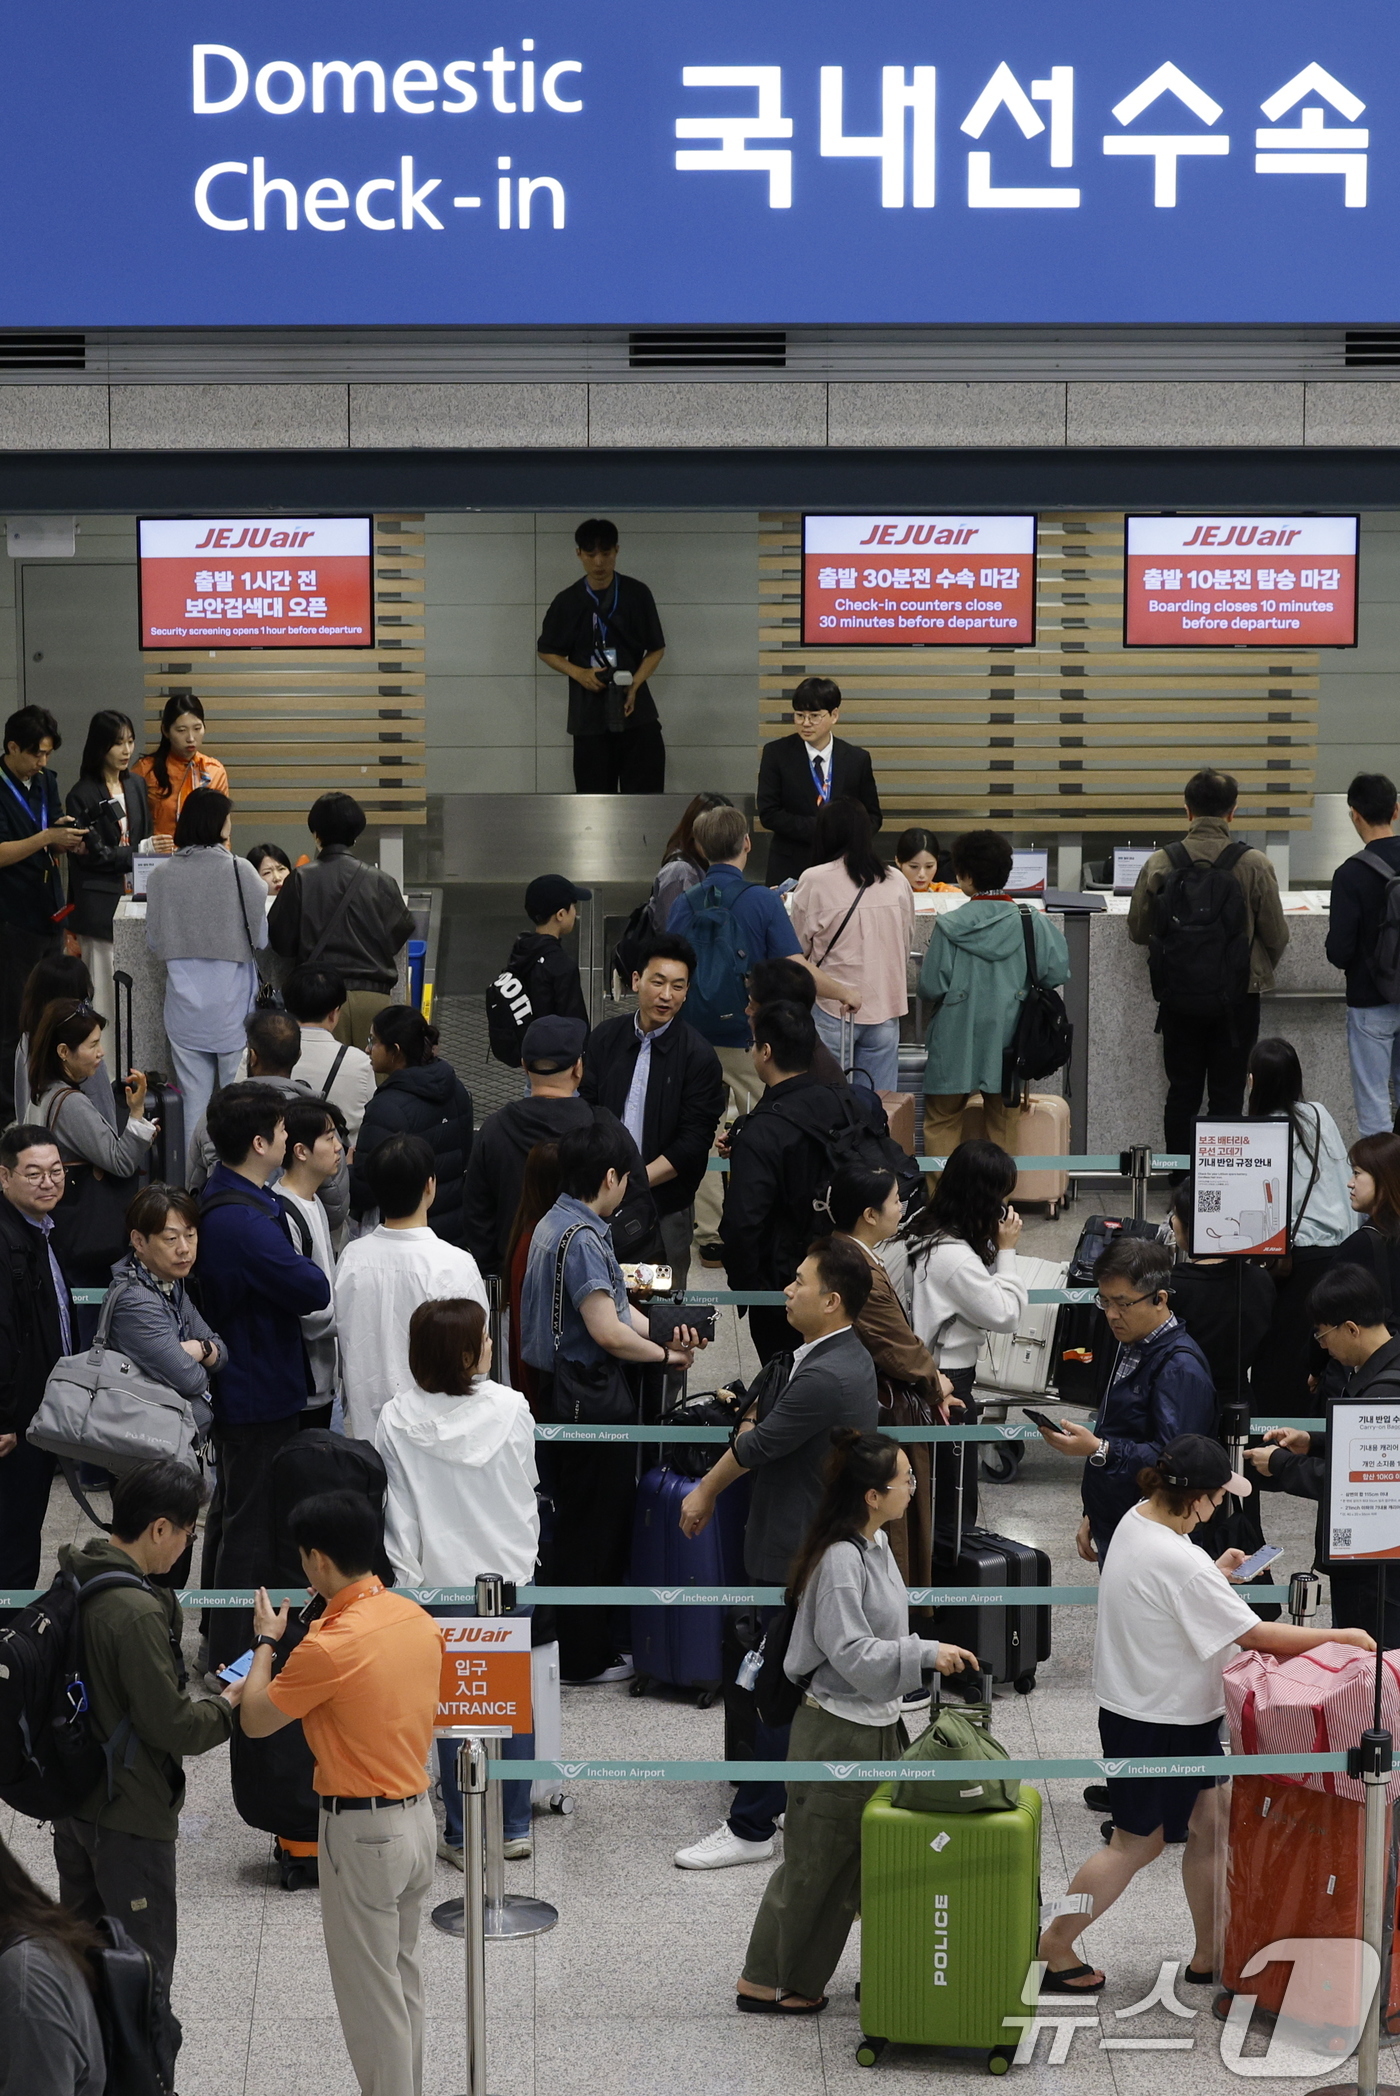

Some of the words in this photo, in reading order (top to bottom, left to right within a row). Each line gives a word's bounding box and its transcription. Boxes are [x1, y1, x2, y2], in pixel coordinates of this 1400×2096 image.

[192, 37, 583, 115] Domestic
[674, 60, 1370, 210] 국내선수속
[193, 154, 566, 233] Check-in
[195, 526, 315, 549] JEJUair
[859, 523, 980, 546] JEJUair
[1182, 524, 1303, 547] JEJUair
[194, 570, 234, 592] 출발
[241, 570, 292, 591] 1시간
[298, 570, 317, 591] 전
[818, 567, 858, 589] 출발
[862, 567, 931, 589] 30분전
[935, 567, 976, 589] 수속
[980, 567, 1020, 589] 마감
[1143, 568, 1183, 590] 출발
[1187, 568, 1252, 590] 10분전
[1256, 568, 1296, 590] 탑승
[1300, 568, 1341, 590] 마감
[184, 597, 283, 619] 보안검색대
[288, 597, 328, 618] 오픈
[835, 598, 897, 611] Check-in
[899, 599, 963, 611] counters
[965, 598, 1003, 611] close
[1149, 599, 1211, 615] Boarding
[1214, 600, 1257, 612] closes
[1260, 600, 1276, 612] 10
[1279, 600, 1334, 612] minutes
[818, 615, 837, 628] 30
[840, 615, 895, 628] minutes
[898, 615, 945, 628] before
[947, 615, 1018, 630] departure
[1182, 616, 1228, 629] before
[1231, 616, 1300, 631] departure
[150, 626, 187, 637] Security
[189, 626, 231, 637] screening
[233, 627, 259, 636] opens
[288, 625, 317, 635] before
[318, 625, 363, 636] departure
[1198, 1136, 1216, 1145] 보조
[1217, 1136, 1250, 1146] 배터리&
[1198, 1147, 1216, 1156] 무선
[1217, 1147, 1243, 1157] 고데기
[1198, 1158, 1216, 1168] 기내
[1217, 1158, 1234, 1168] 반입
[1235, 1158, 1253, 1168] 규정
[1254, 1158, 1272, 1168] 안내
[1358, 1415, 1374, 1424] 기내
[1375, 1415, 1391, 1423] 반입
[562, 1430, 596, 1439] Incheon
[598, 1431, 629, 1441] Airport
[1024, 1430, 1042, 1438] Inch
[189, 1596, 226, 1605] Incheon
[228, 1596, 255, 1606] Airpo
[682, 1594, 719, 1602] Incheon
[721, 1593, 755, 1603] Airport
[931, 1594, 968, 1603] Incheon
[970, 1594, 1003, 1604] Airport
[440, 1627, 513, 1643] EJUair
[455, 1660, 488, 1676] 입구
[455, 1680, 487, 1696] 入口
[437, 1701, 517, 1715] NTRANCE
[587, 1767, 627, 1777] Incheon
[629, 1767, 665, 1779] Airport
[858, 1768, 897, 1778] Incheon
[899, 1768, 936, 1779] Airport
[1128, 1764, 1167, 1774] Incheon
[1169, 1764, 1206, 1775] Airport
[933, 1894, 949, 1987] POLICE
